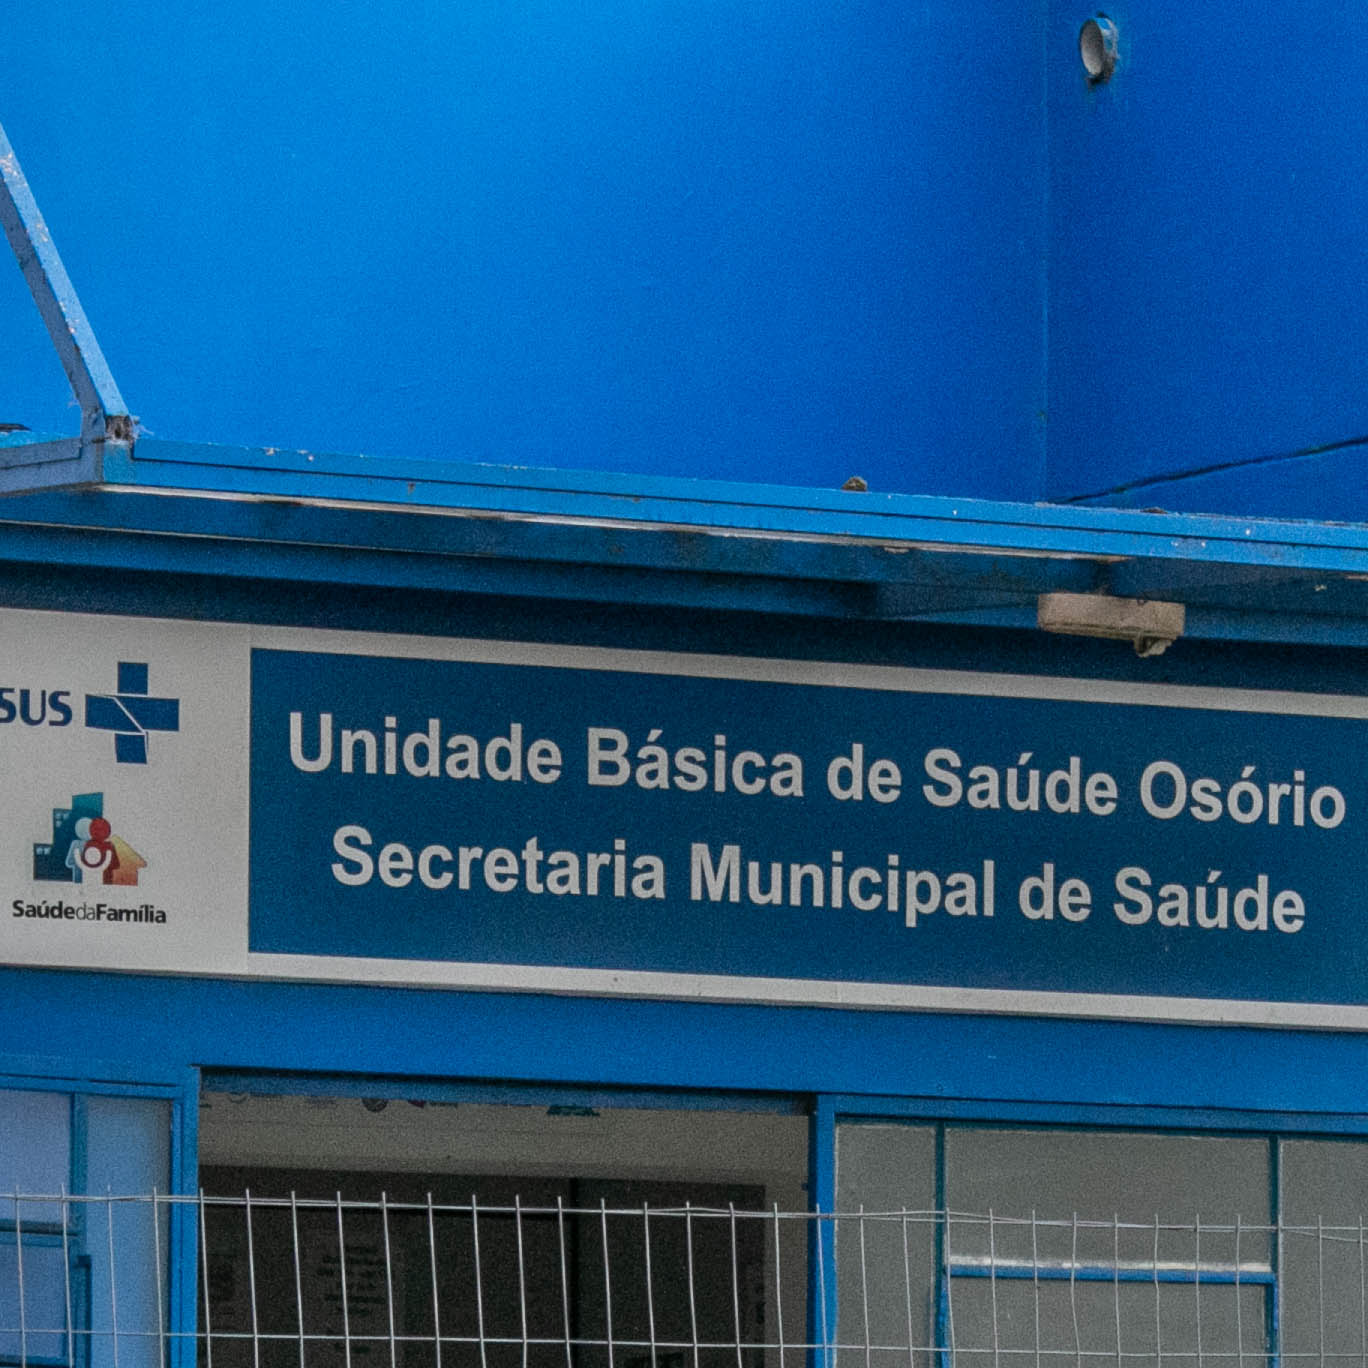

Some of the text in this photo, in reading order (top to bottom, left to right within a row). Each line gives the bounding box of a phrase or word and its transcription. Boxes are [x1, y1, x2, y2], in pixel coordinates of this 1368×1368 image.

[288, 711, 1346, 829] Unidade Básica de Saúde Osório
[331, 824, 1306, 934] Secretaria Municipal de Saúde
